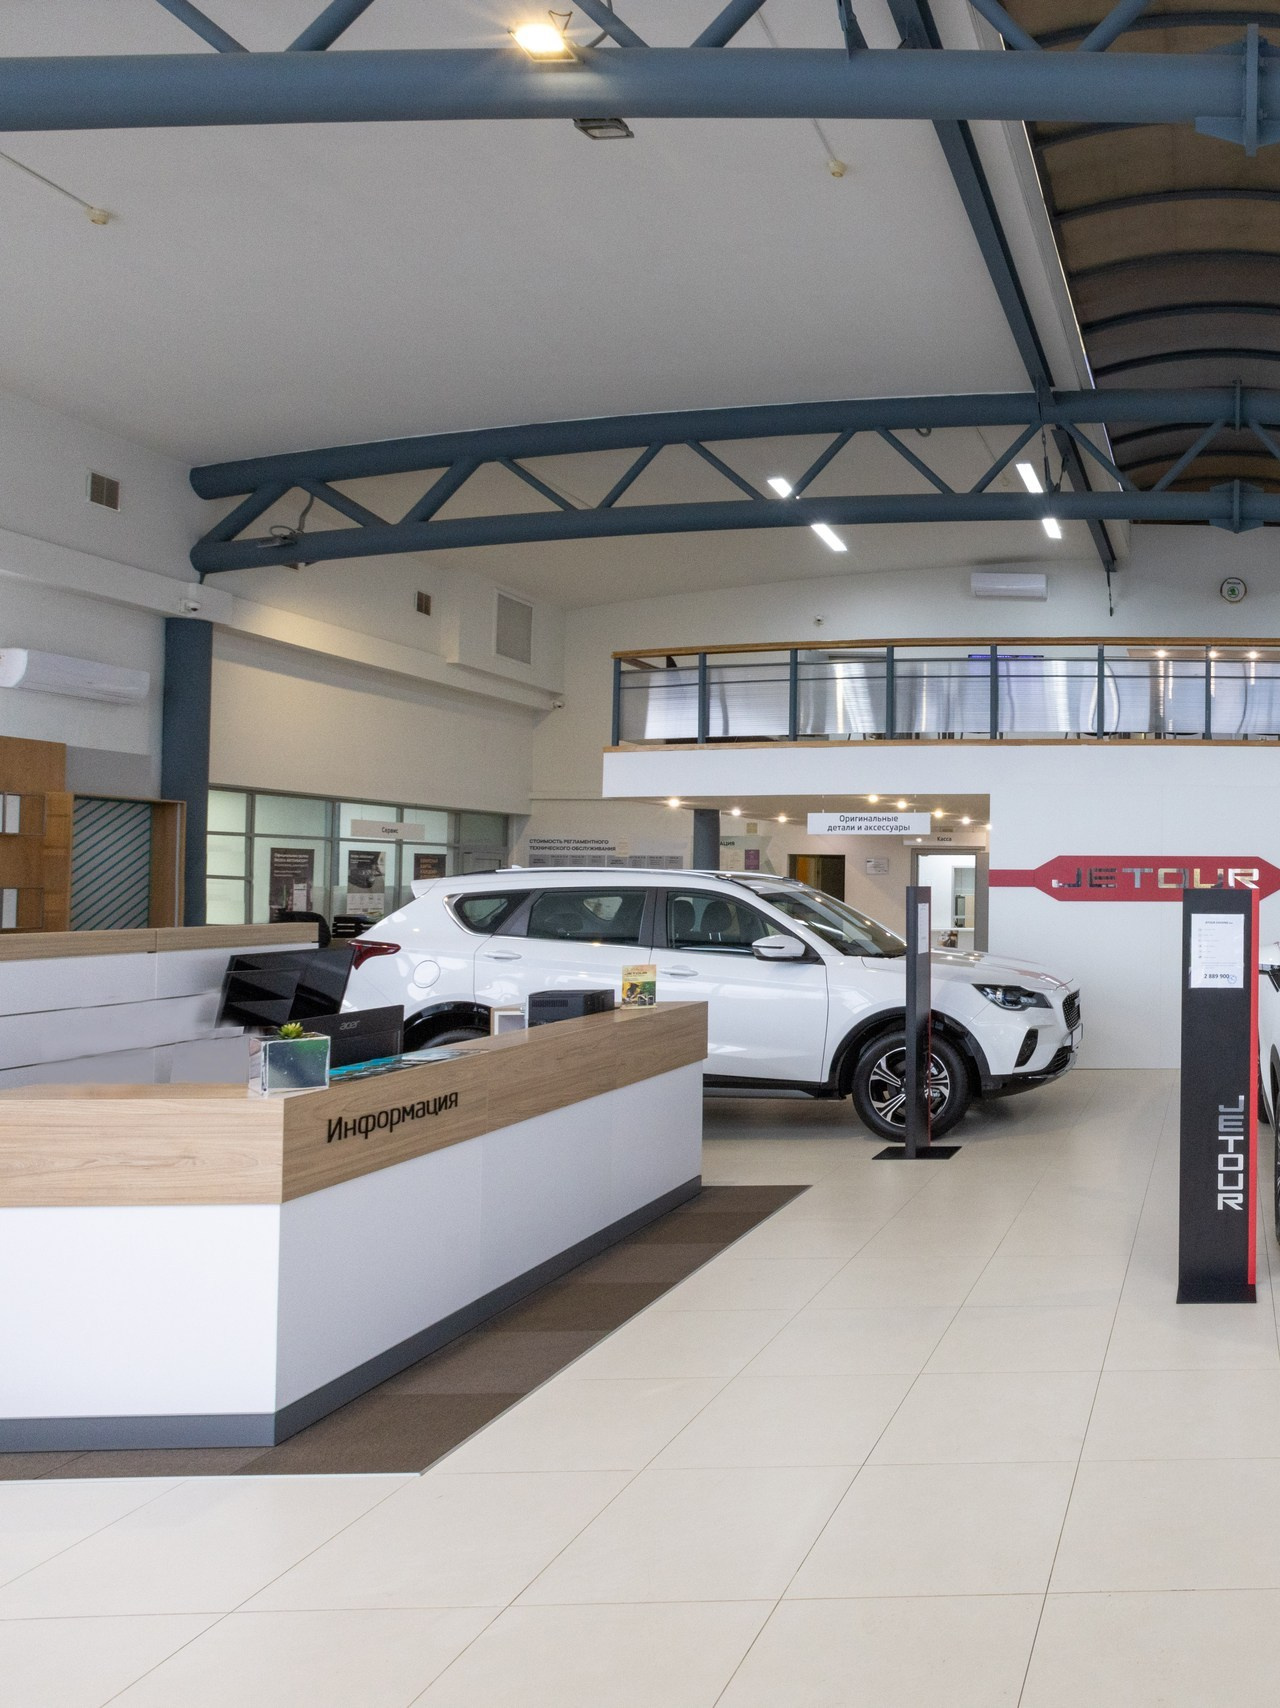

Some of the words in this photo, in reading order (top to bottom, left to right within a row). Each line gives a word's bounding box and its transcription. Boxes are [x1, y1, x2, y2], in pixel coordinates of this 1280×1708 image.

[839, 814, 899, 823] Оригинальные
[381, 826, 399, 834] Сервис
[827, 824, 856, 832] детали
[864, 825, 911, 833] аксессуары
[1051, 867, 1260, 889] JETOUR
[339, 1020, 360, 1031] acer
[327, 1092, 458, 1143] Информация
[1217, 1094, 1244, 1211] JETOUR
